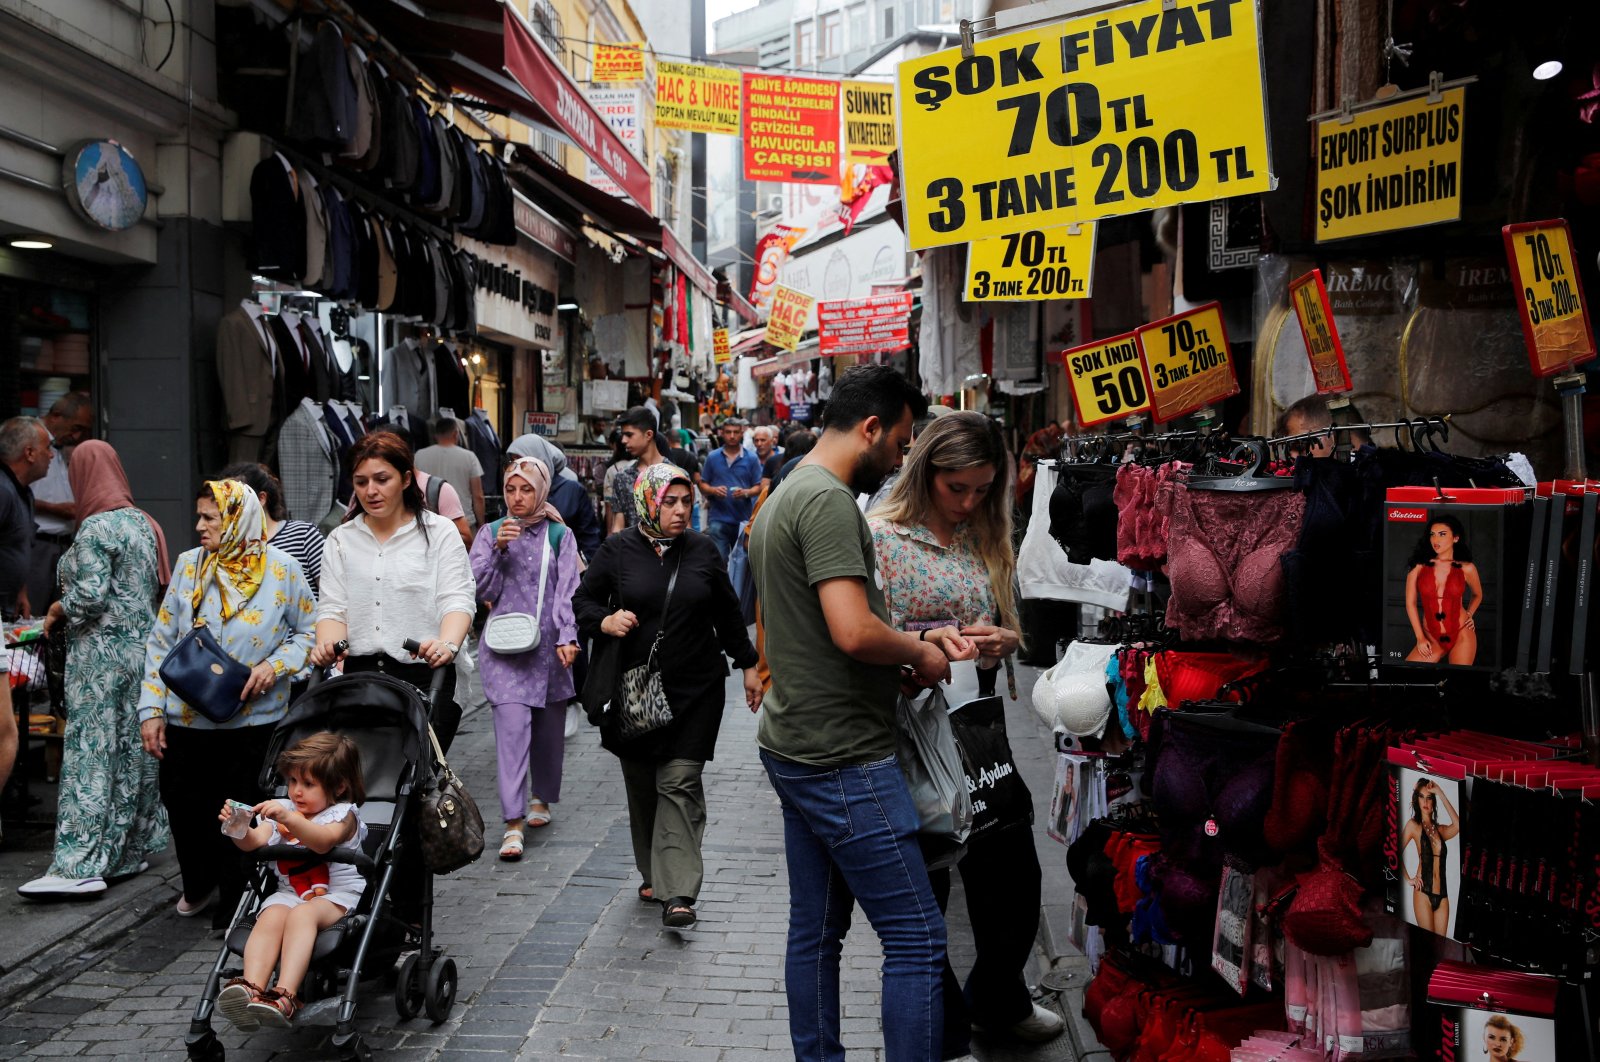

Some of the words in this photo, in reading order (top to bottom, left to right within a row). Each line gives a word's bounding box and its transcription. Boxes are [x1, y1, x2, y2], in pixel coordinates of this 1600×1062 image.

[913, 42, 1044, 111] ŞOK
[1060, 0, 1243, 74] FİYAT
[657, 76, 684, 104] HAC
[689, 79, 698, 105] &
[703, 81, 740, 111] UMRE
[750, 77, 781, 93] ABİYE
[846, 86, 892, 115] SÜNNET
[656, 105, 684, 119] TOPTAN
[750, 93, 772, 105] KINA
[774, 95, 834, 111] MALZEMELERİ
[750, 106, 801, 121] BİNDALLI
[750, 120, 815, 137] ÇEYİZCİLER
[847, 119, 896, 146] KIYAFETLERİ
[997, 82, 1102, 158] 70
[1106, 94, 1154, 133] TL
[750, 136, 836, 154] HAVLUCULAR
[1320, 123, 1380, 171] EXPORT
[1382, 103, 1460, 158] SURPLUS
[754, 151, 832, 168] ÇARŞISI
[926, 177, 966, 233] 3
[972, 167, 1078, 221] TANE
[1091, 128, 1200, 206] 200
[1209, 146, 1254, 184] TL
[1320, 181, 1362, 228] ŞOK
[1366, 159, 1457, 214] İNDİRİM
[1001, 230, 1045, 268] 70
[1046, 246, 1067, 264] TL
[1524, 233, 1554, 283] 70
[1551, 254, 1564, 277] TL
[973, 270, 991, 299] 3
[992, 279, 1023, 297] TANE
[1027, 267, 1071, 295] 200
[1071, 278, 1084, 293] TL
[771, 300, 807, 328] HAC
[1525, 287, 1540, 326] 3
[1538, 299, 1556, 321] TANE
[1551, 278, 1577, 317] 200
[1571, 294, 1579, 310] TL
[1162, 319, 1194, 357] 70
[1194, 328, 1210, 345] TL
[1071, 349, 1104, 379] ŞOK
[1156, 363, 1169, 389] 3
[1168, 366, 1189, 384] TANE
[1188, 345, 1217, 375] 200
[1217, 351, 1227, 363] TL
[1091, 366, 1147, 415] 50
[531, 424, 547, 434] 100
[1389, 510, 1425, 520] Sistina
[965, 775, 977, 794] &
[978, 761, 1013, 789] Aydın
